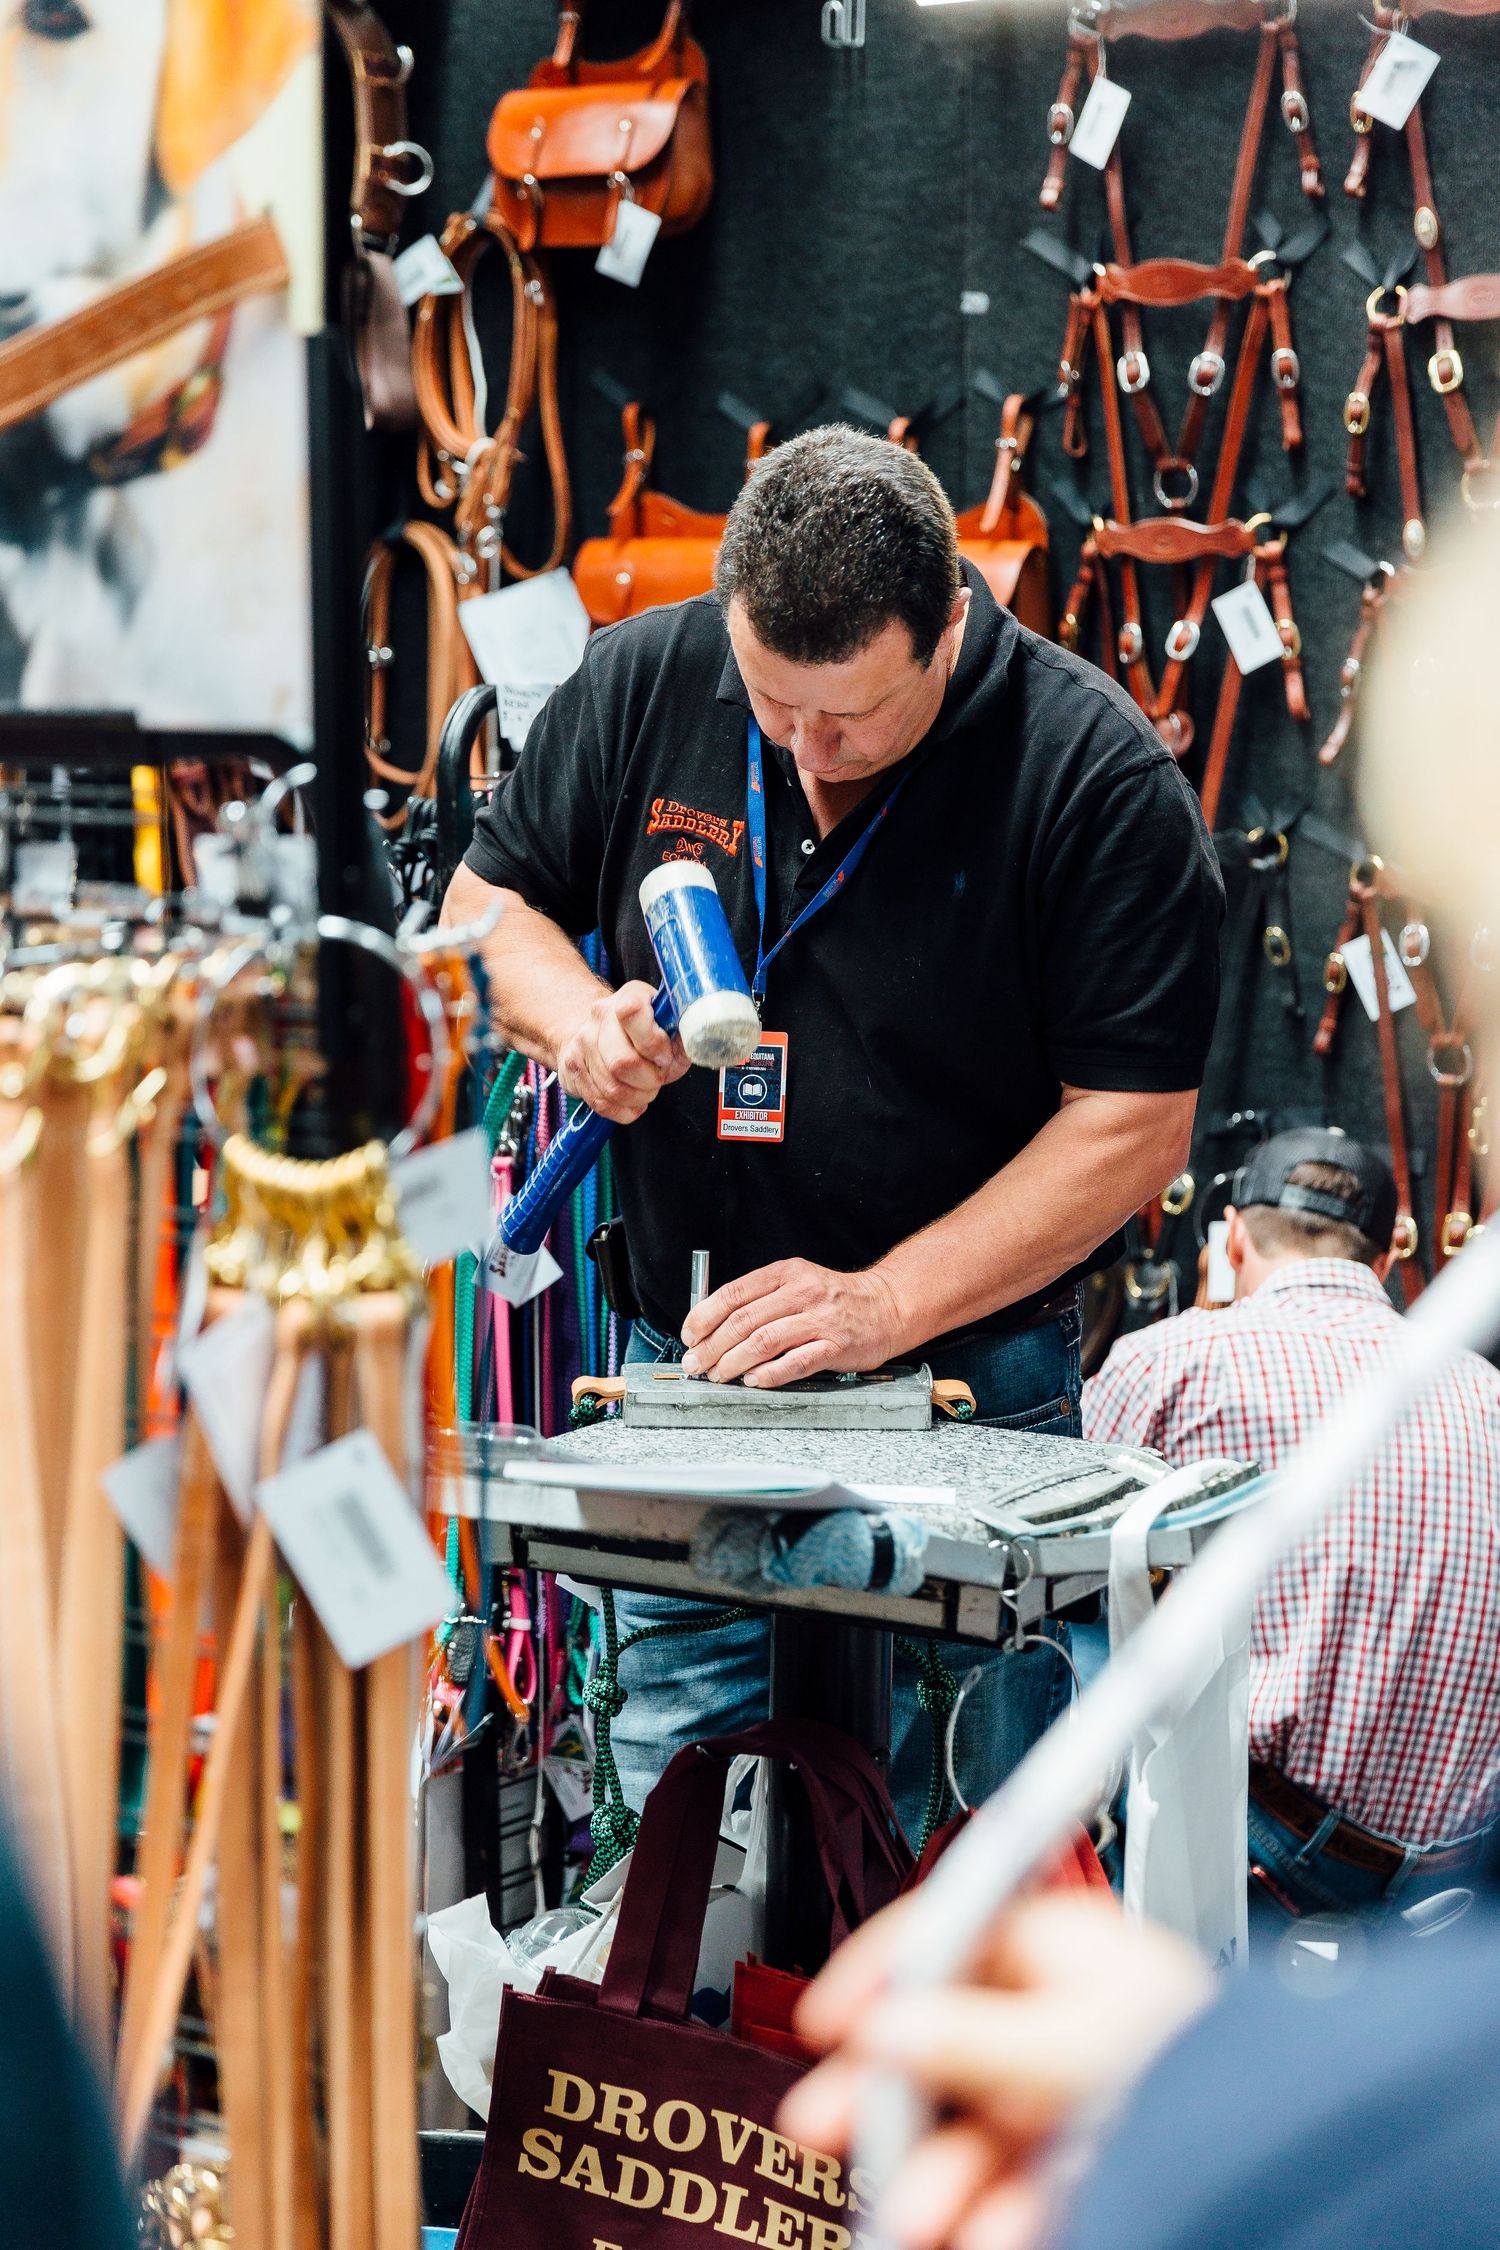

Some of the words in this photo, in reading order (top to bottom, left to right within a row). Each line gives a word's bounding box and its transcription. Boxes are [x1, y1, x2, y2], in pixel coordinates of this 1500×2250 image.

[646, 798, 745, 857] SADDLERY
[665, 800, 728, 828] Drovers
[722, 1123, 749, 1132] Drovers
[750, 1125, 779, 1136] Saddlery
[735, 1111, 767, 1120] EXHIBITOR
[543, 2068, 884, 2217] DROVERS
[517, 2127, 870, 2250] SADDLER
